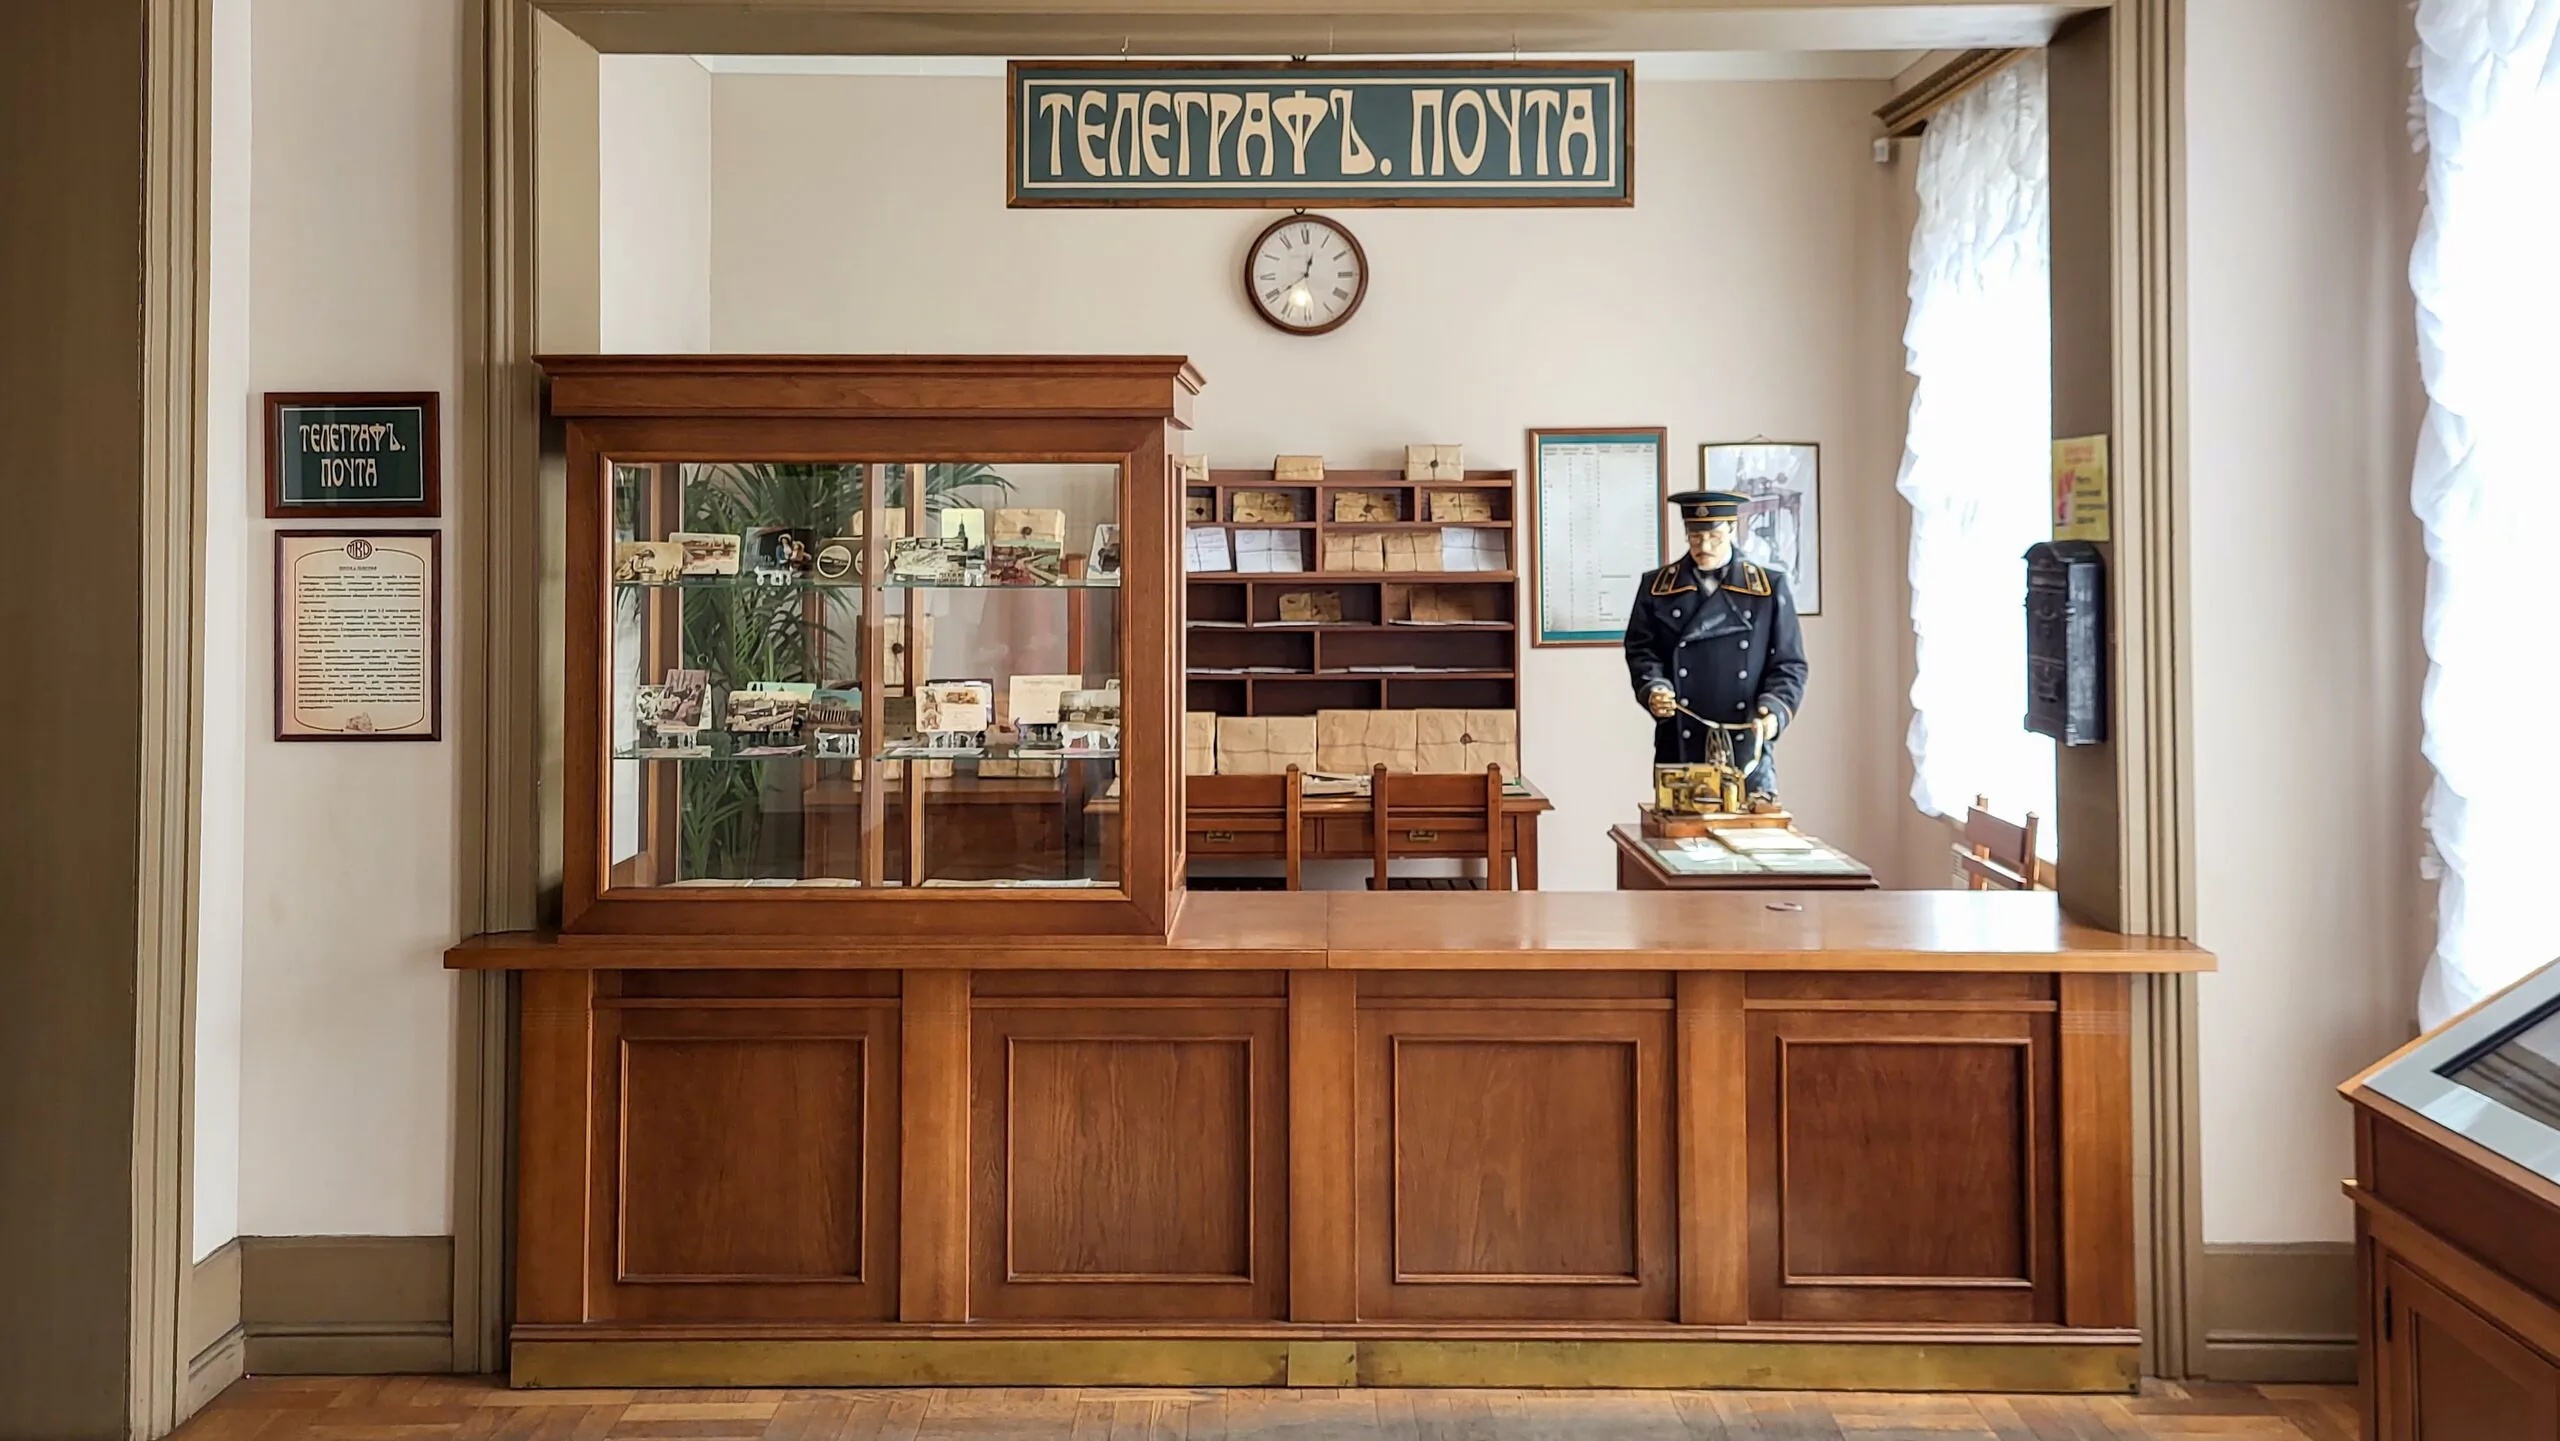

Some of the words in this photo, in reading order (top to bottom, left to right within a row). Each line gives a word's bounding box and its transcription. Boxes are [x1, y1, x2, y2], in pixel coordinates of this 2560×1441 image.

[1039, 89, 1393, 177] ТЕЛЕГРАФЪ.
[1410, 88, 1598, 176] ПОЧТА
[299, 423, 406, 453] ТЕЛЕГРАФЪ.
[321, 458, 378, 487] ПОЧТА
